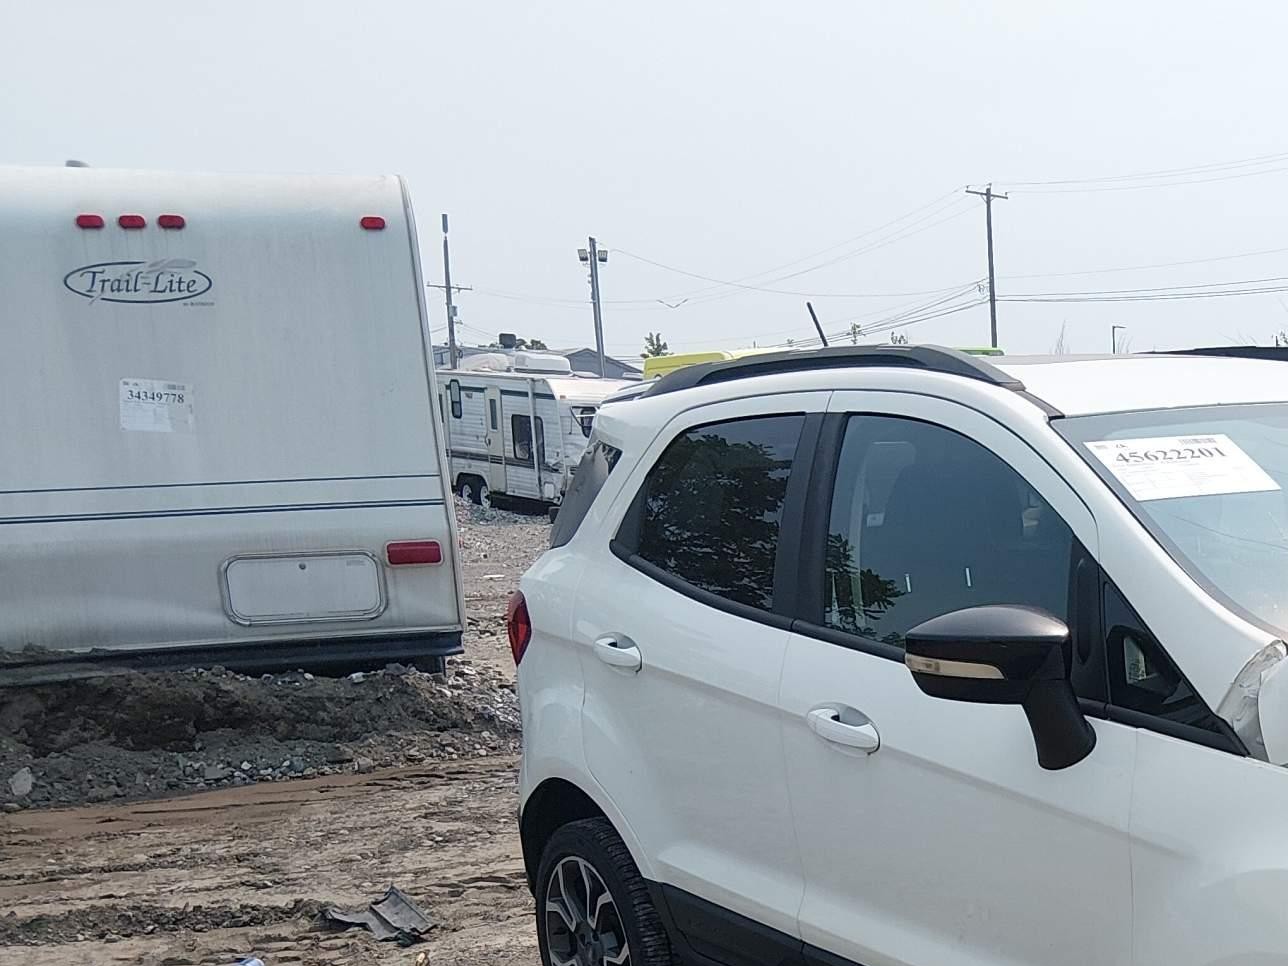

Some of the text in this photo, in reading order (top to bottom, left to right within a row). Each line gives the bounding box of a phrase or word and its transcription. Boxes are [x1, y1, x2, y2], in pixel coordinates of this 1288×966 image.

[80, 269, 199, 294] Trail-Lite
[127, 389, 185, 404] 34349778
[1115, 447, 1226, 462] 45622201
